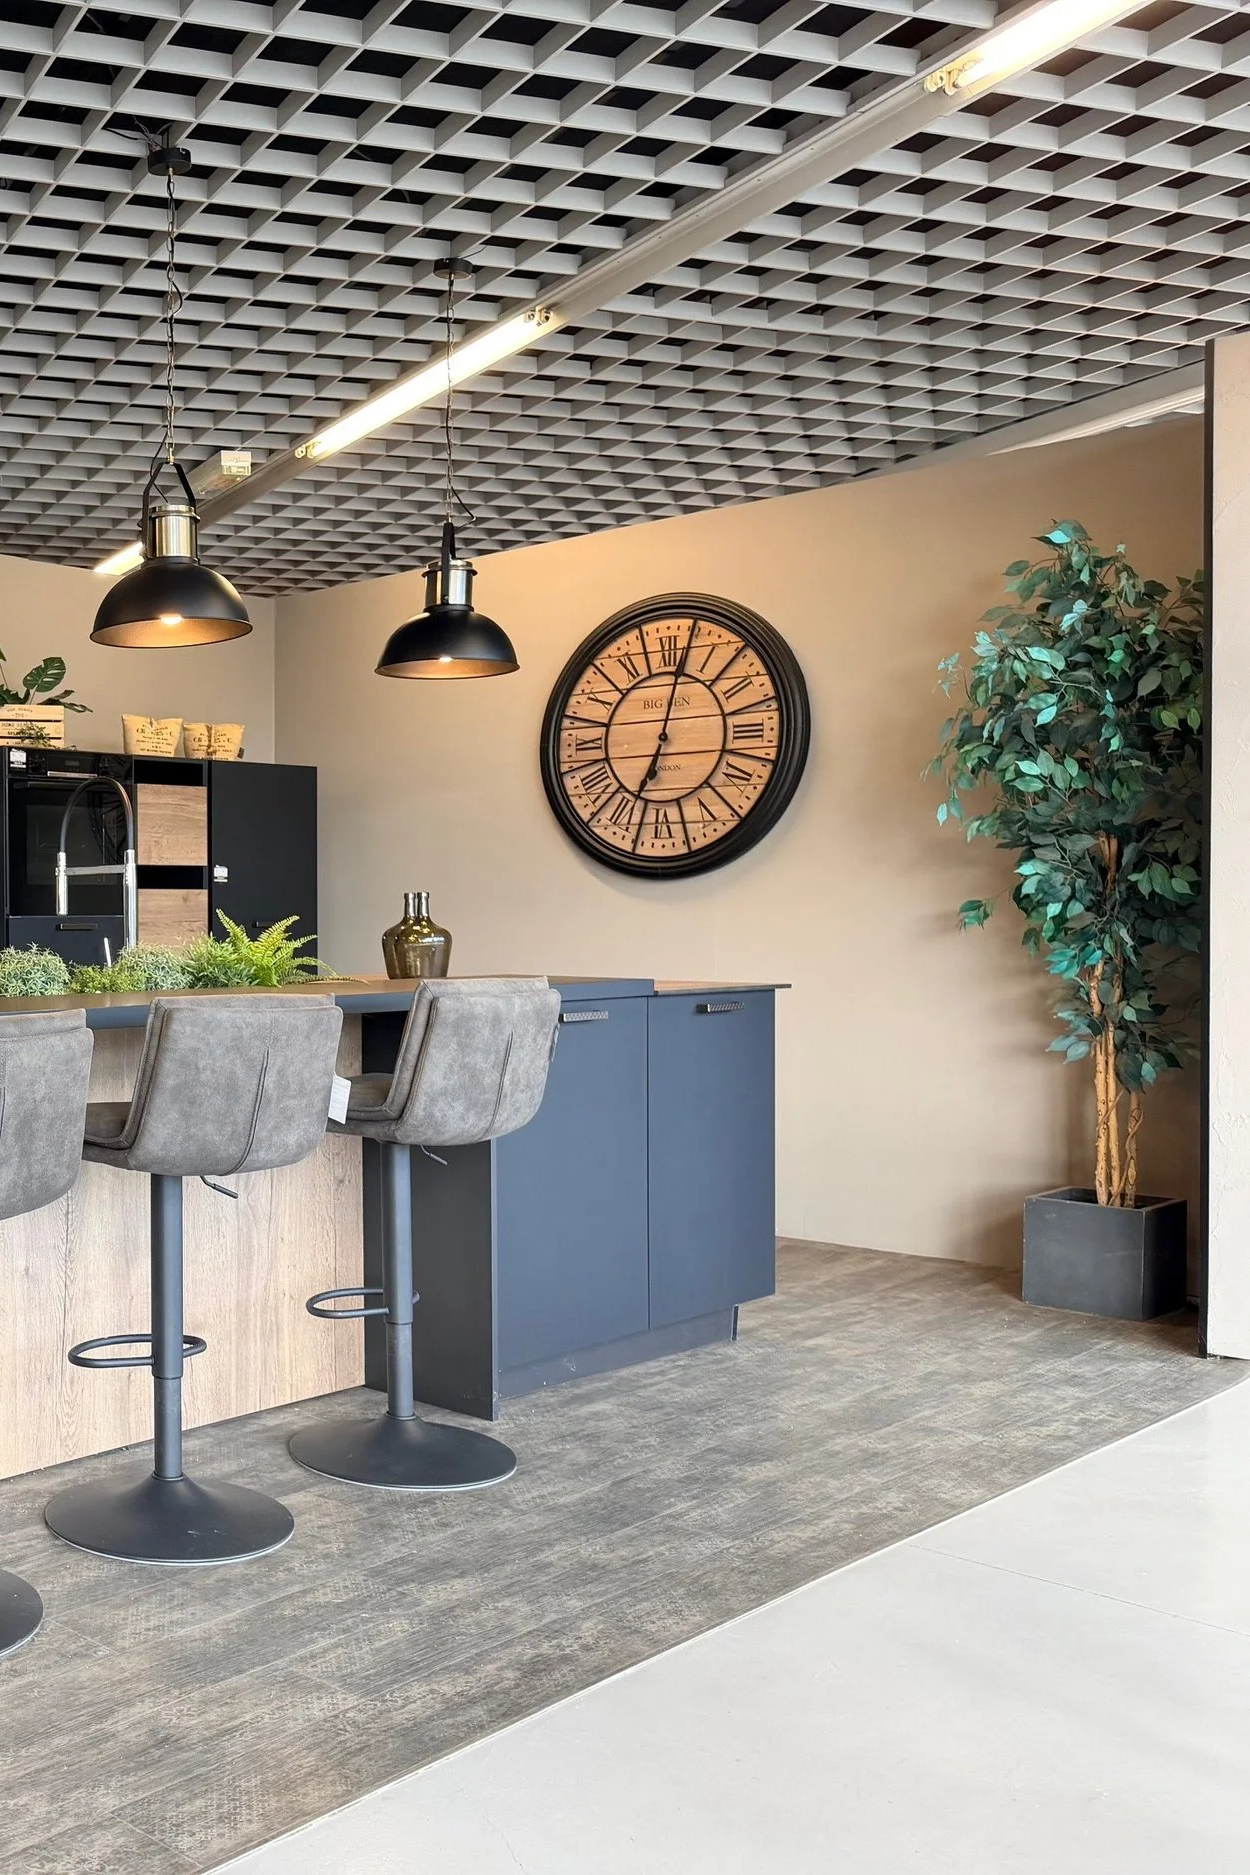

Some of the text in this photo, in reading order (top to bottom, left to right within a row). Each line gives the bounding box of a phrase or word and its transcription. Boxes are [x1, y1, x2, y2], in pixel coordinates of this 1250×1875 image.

[613, 650, 644, 687] XI
[655, 635, 681, 670] XII
[643, 699, 663, 710] BIG
[731, 718, 765, 744] III
[578, 761, 614, 808] VIII
[650, 807, 676, 839] VI
